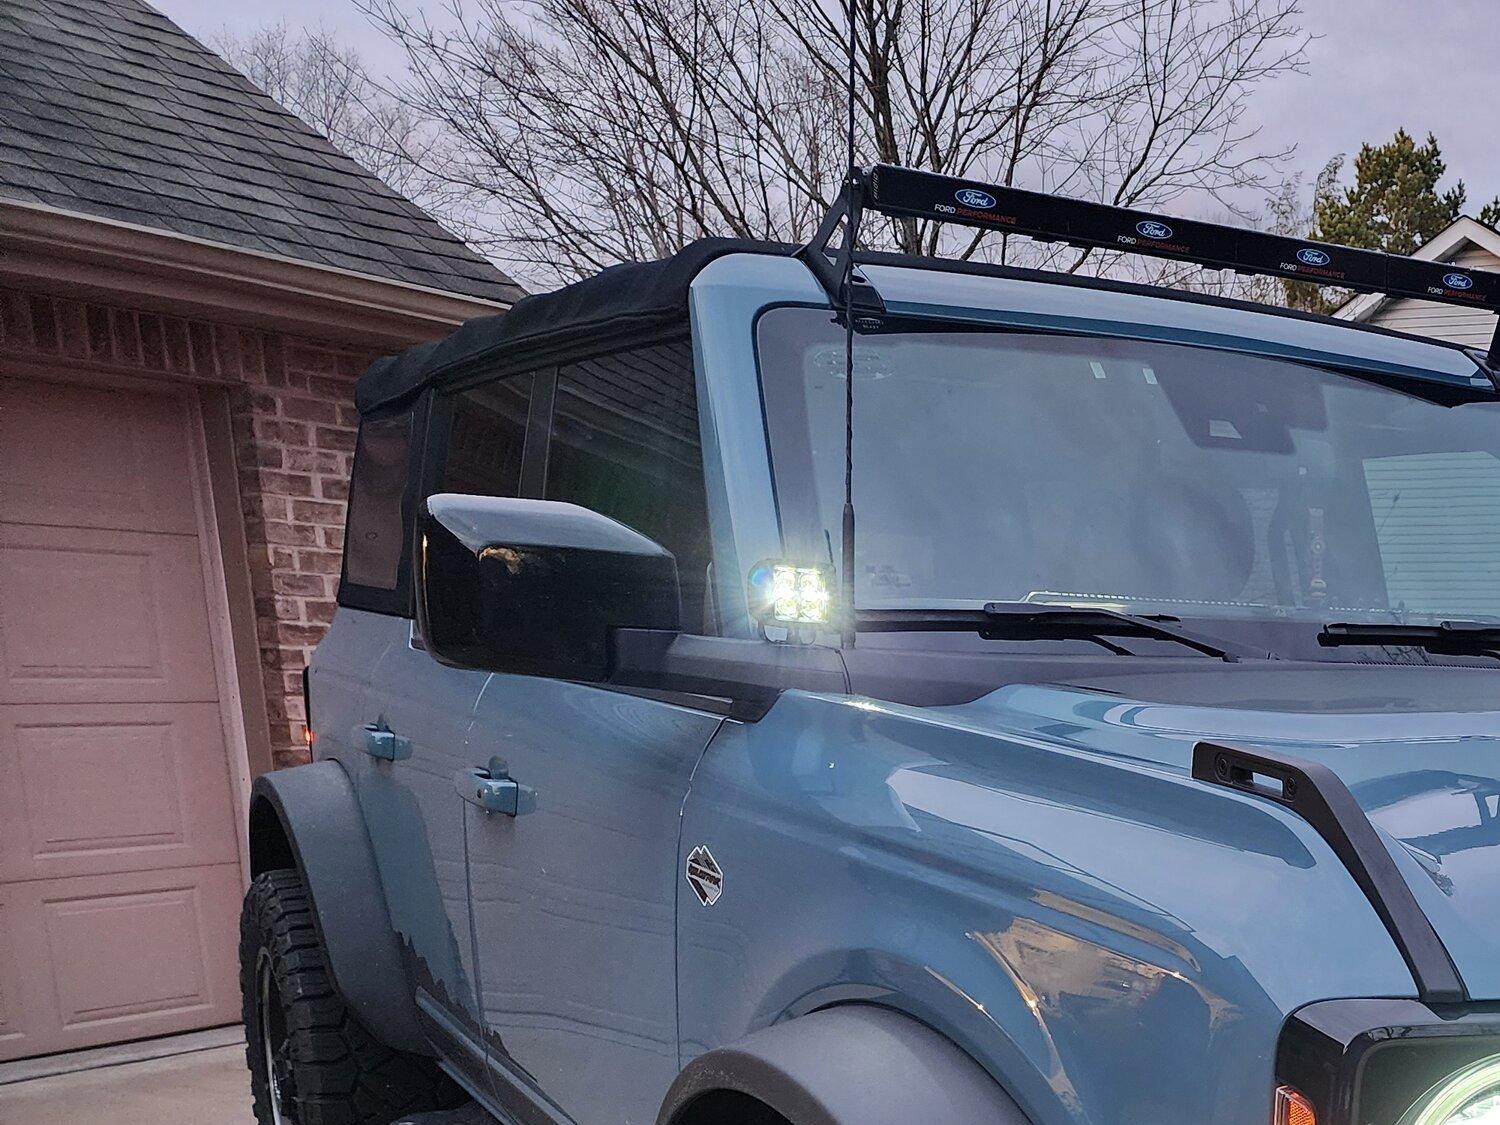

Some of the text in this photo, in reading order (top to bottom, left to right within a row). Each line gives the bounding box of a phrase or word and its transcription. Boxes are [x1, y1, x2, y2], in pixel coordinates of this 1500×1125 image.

[960, 190, 991, 207] Ford
[934, 203, 1017, 225] FORD PERFORMANCE
[1140, 222, 1168, 238] Ford
[1117, 235, 1137, 245] FORD
[1301, 250, 1326, 264] Ford
[1280, 262, 1297, 271] FORD
[1447, 274, 1469, 288] Ford
[1428, 286, 1443, 295] FORD
